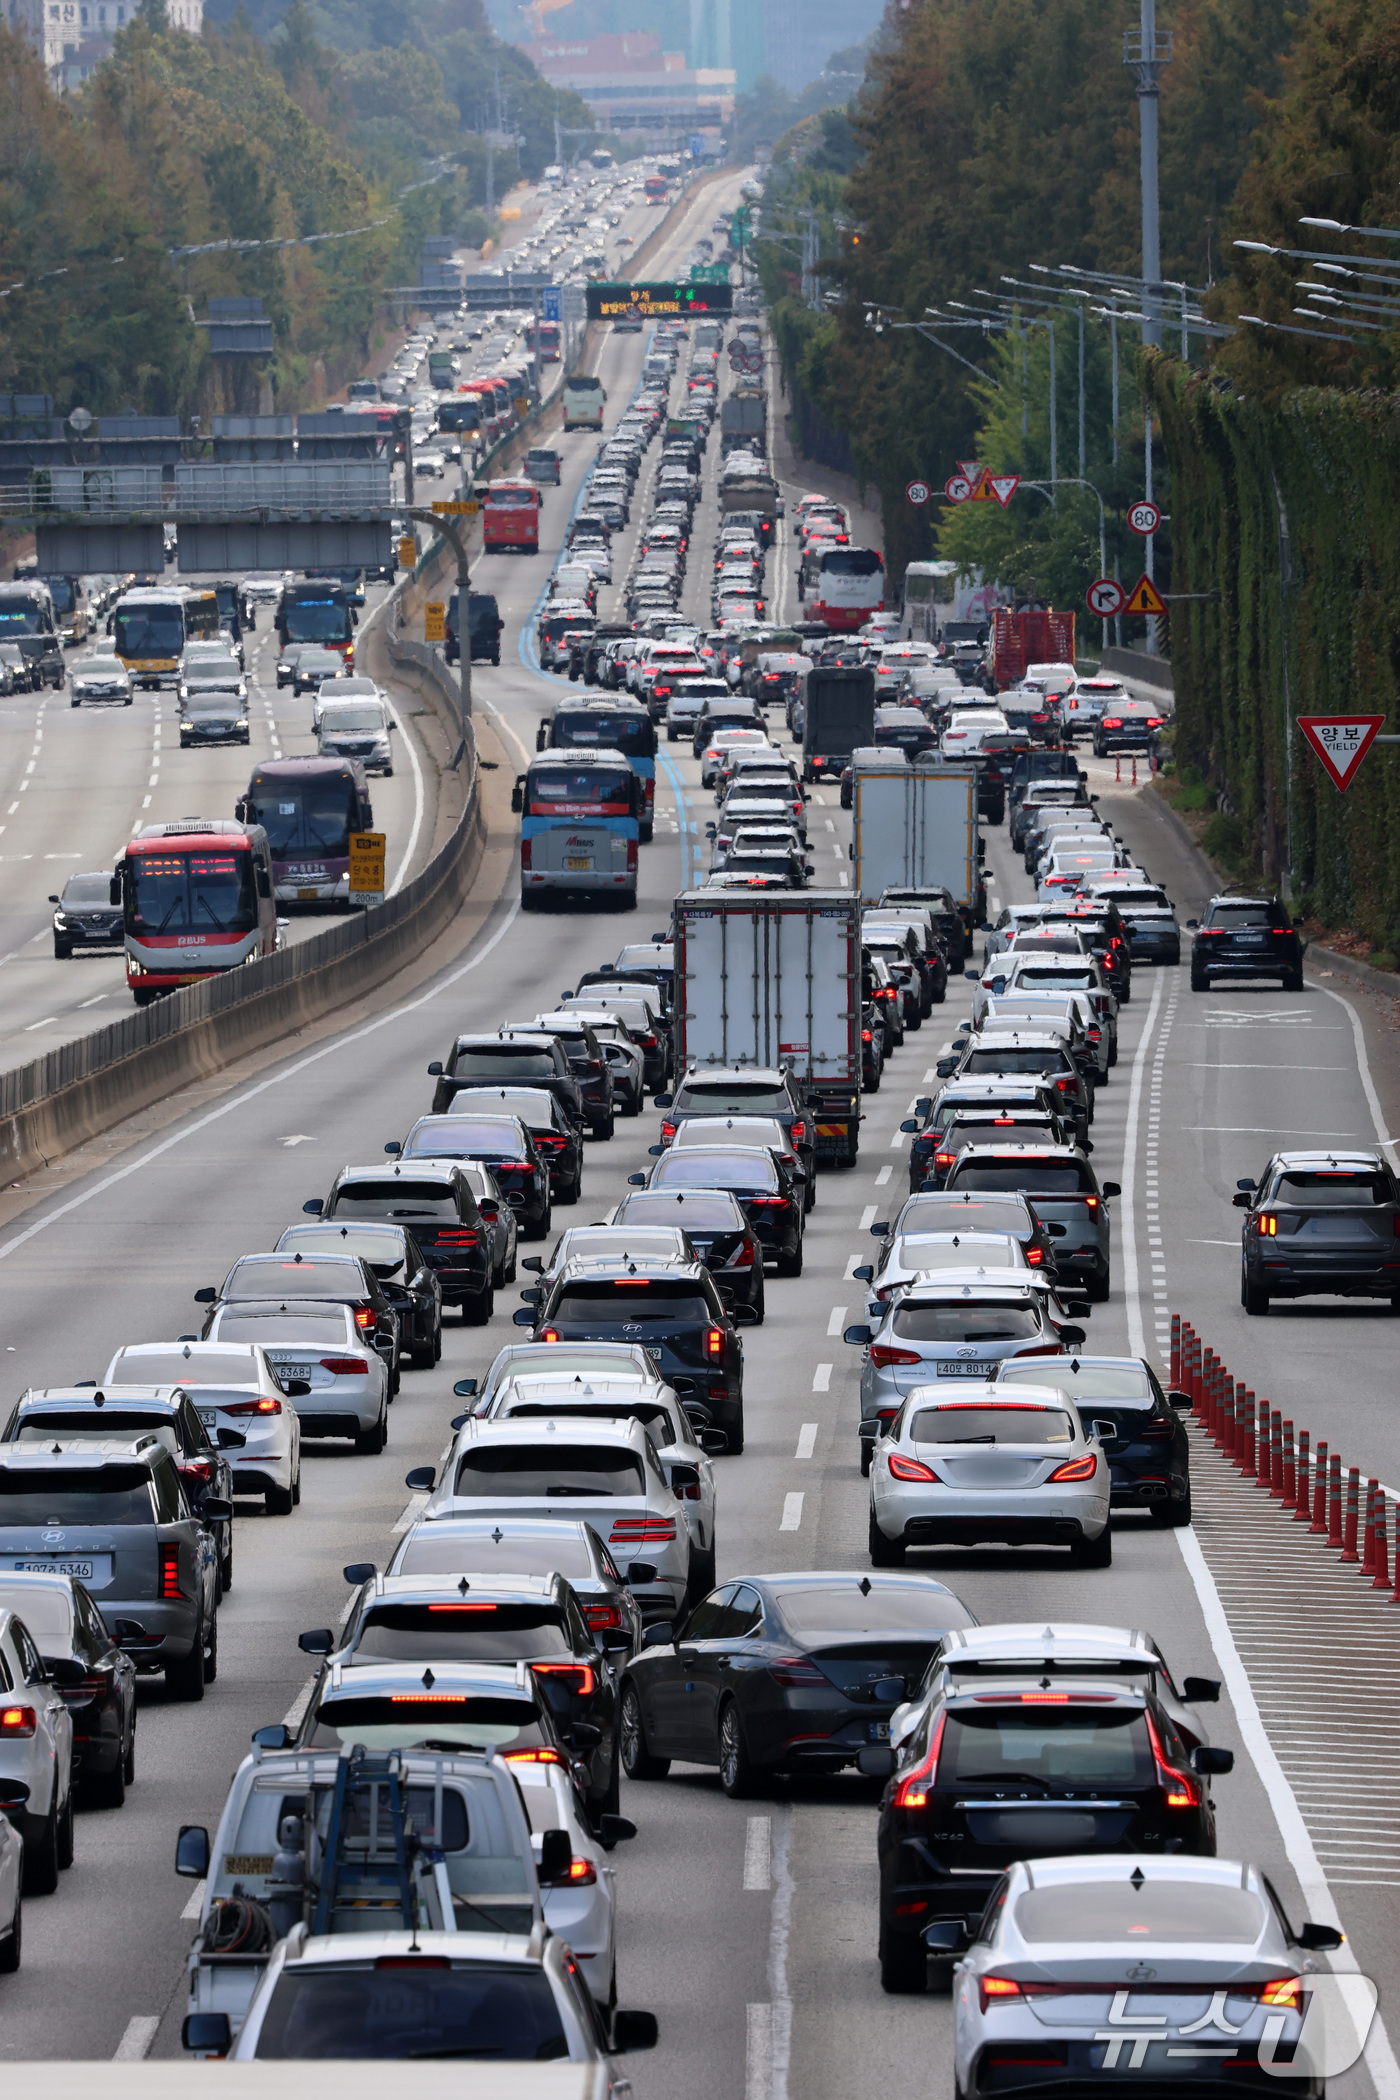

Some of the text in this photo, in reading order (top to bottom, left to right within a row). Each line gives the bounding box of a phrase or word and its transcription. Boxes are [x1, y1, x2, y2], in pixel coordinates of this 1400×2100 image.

[911, 487, 925, 500] 80
[1135, 511, 1155, 526] 80
[1321, 727, 1360, 742] 양보
[355, 893, 378, 903] 200m
[281, 1367, 305, 1377] 5368
[966, 1364, 991, 1373] 8014
[60, 1564, 89, 1576] 5346
